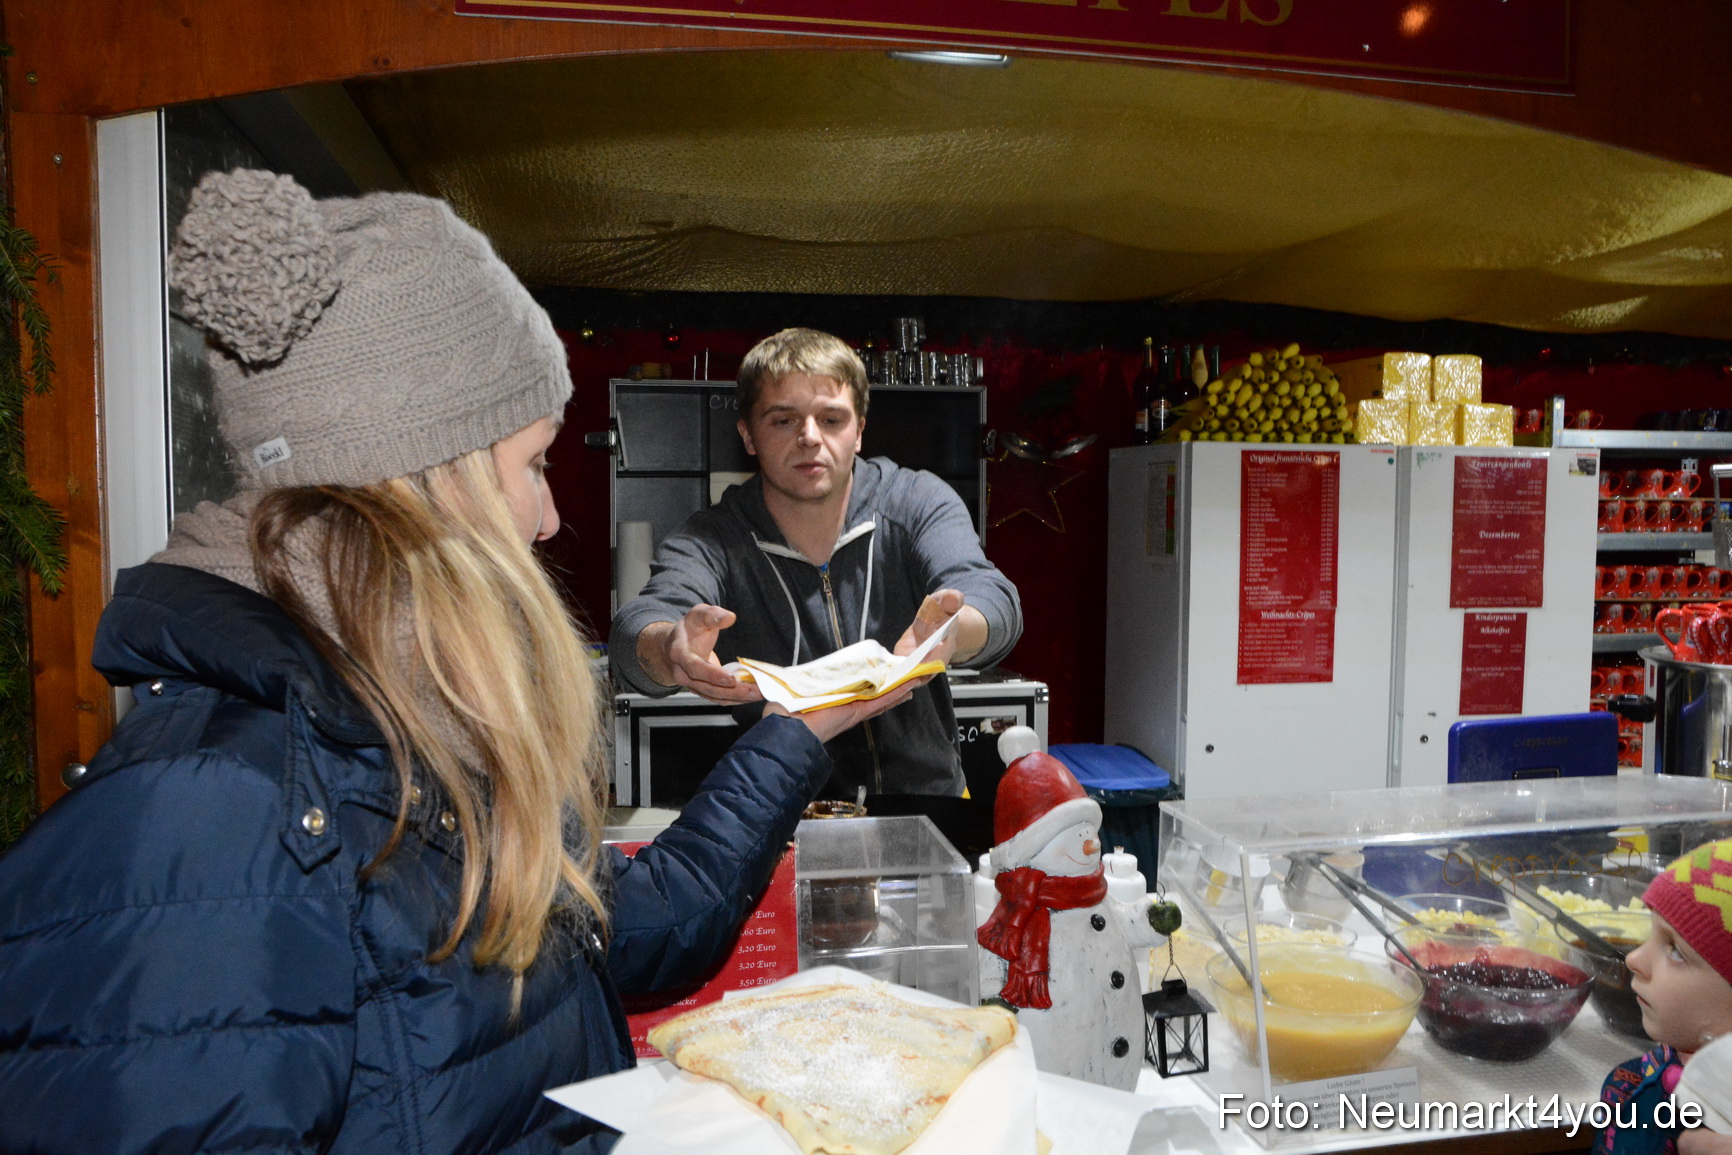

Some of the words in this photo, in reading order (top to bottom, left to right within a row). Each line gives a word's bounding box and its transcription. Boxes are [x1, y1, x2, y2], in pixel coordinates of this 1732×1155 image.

[1479, 530, 1520, 539] Dezembertee
[1475, 614, 1517, 623] Kinderpunsch
[1480, 627, 1511, 636] Alkoholfrei
[755, 911, 776, 919] Euro
[741, 928, 754, 936] ,60
[756, 927, 776, 935] Euro
[738, 946, 755, 954] 3,20
[756, 944, 777, 952] Euro
[738, 962, 755, 971] 3,20
[757, 960, 777, 969] Euro
[739, 979, 755, 988] 3,50
[757, 977, 777, 985] Euro
[1327, 1079, 1344, 1089] Liebe
[1344, 1079, 1361, 1087] Gäste
[1321, 1092, 1336, 1100] über
[1368, 1084, 1393, 1093] unseren
[1393, 1080, 1416, 1090] Speisen
[1385, 1092, 1400, 1100] oder
